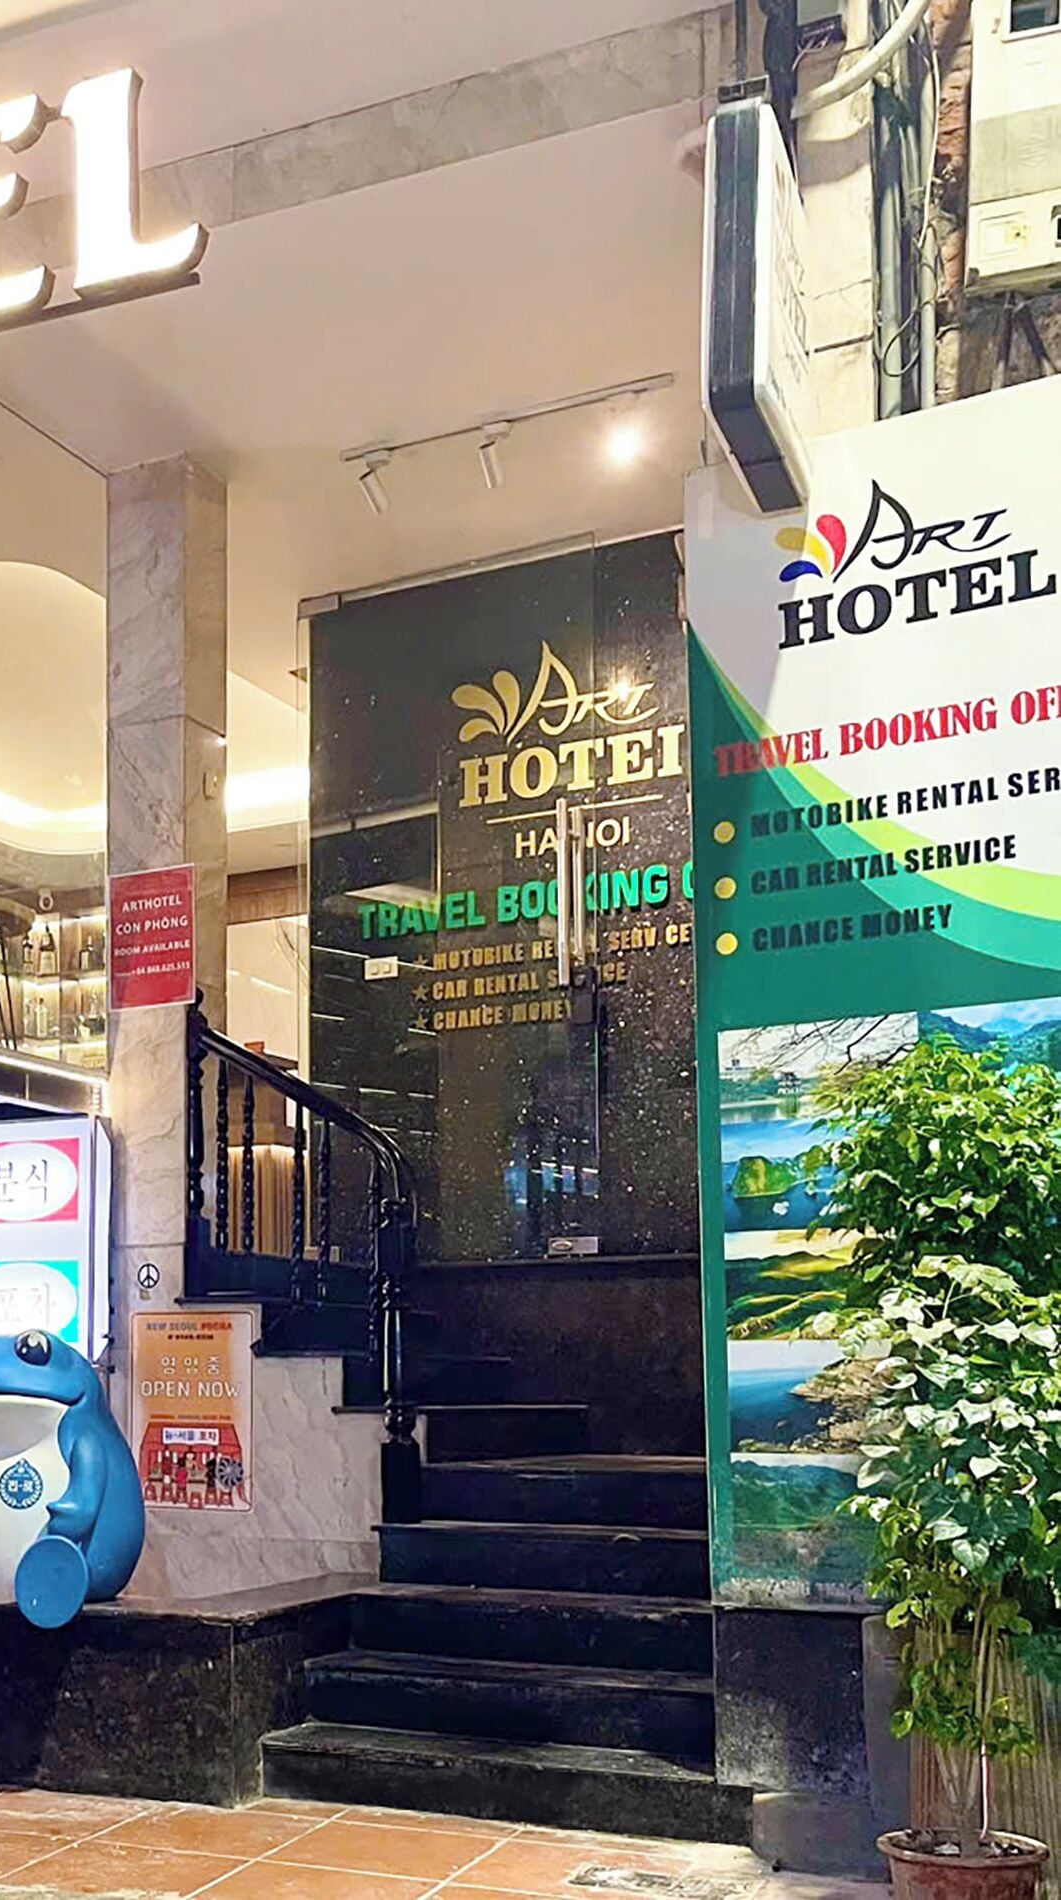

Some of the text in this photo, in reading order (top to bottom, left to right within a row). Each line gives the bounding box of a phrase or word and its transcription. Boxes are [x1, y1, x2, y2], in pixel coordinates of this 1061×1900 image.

[778, 550, 1057, 650] HOTEL
[714, 684, 1061, 778] TRAVEL BOOKING OF
[750, 794, 888, 838] MOTOBIKE
[897, 777, 999, 815] RENTAL
[751, 835, 1016, 896] CAR RENTAL SERVICE
[122, 894, 183, 913] ARTHOTEL
[357, 890, 486, 940] TRAVEL
[860, 904, 952, 939] MONEY
[142, 940, 190, 954] AVAILABLE
[608, 921, 691, 951] SERVCE
[433, 942, 525, 972] MOTOBIKE
[432, 961, 628, 1001] CAR RENTAL SICE
[141, 1381, 241, 1398] OPEN NOW
